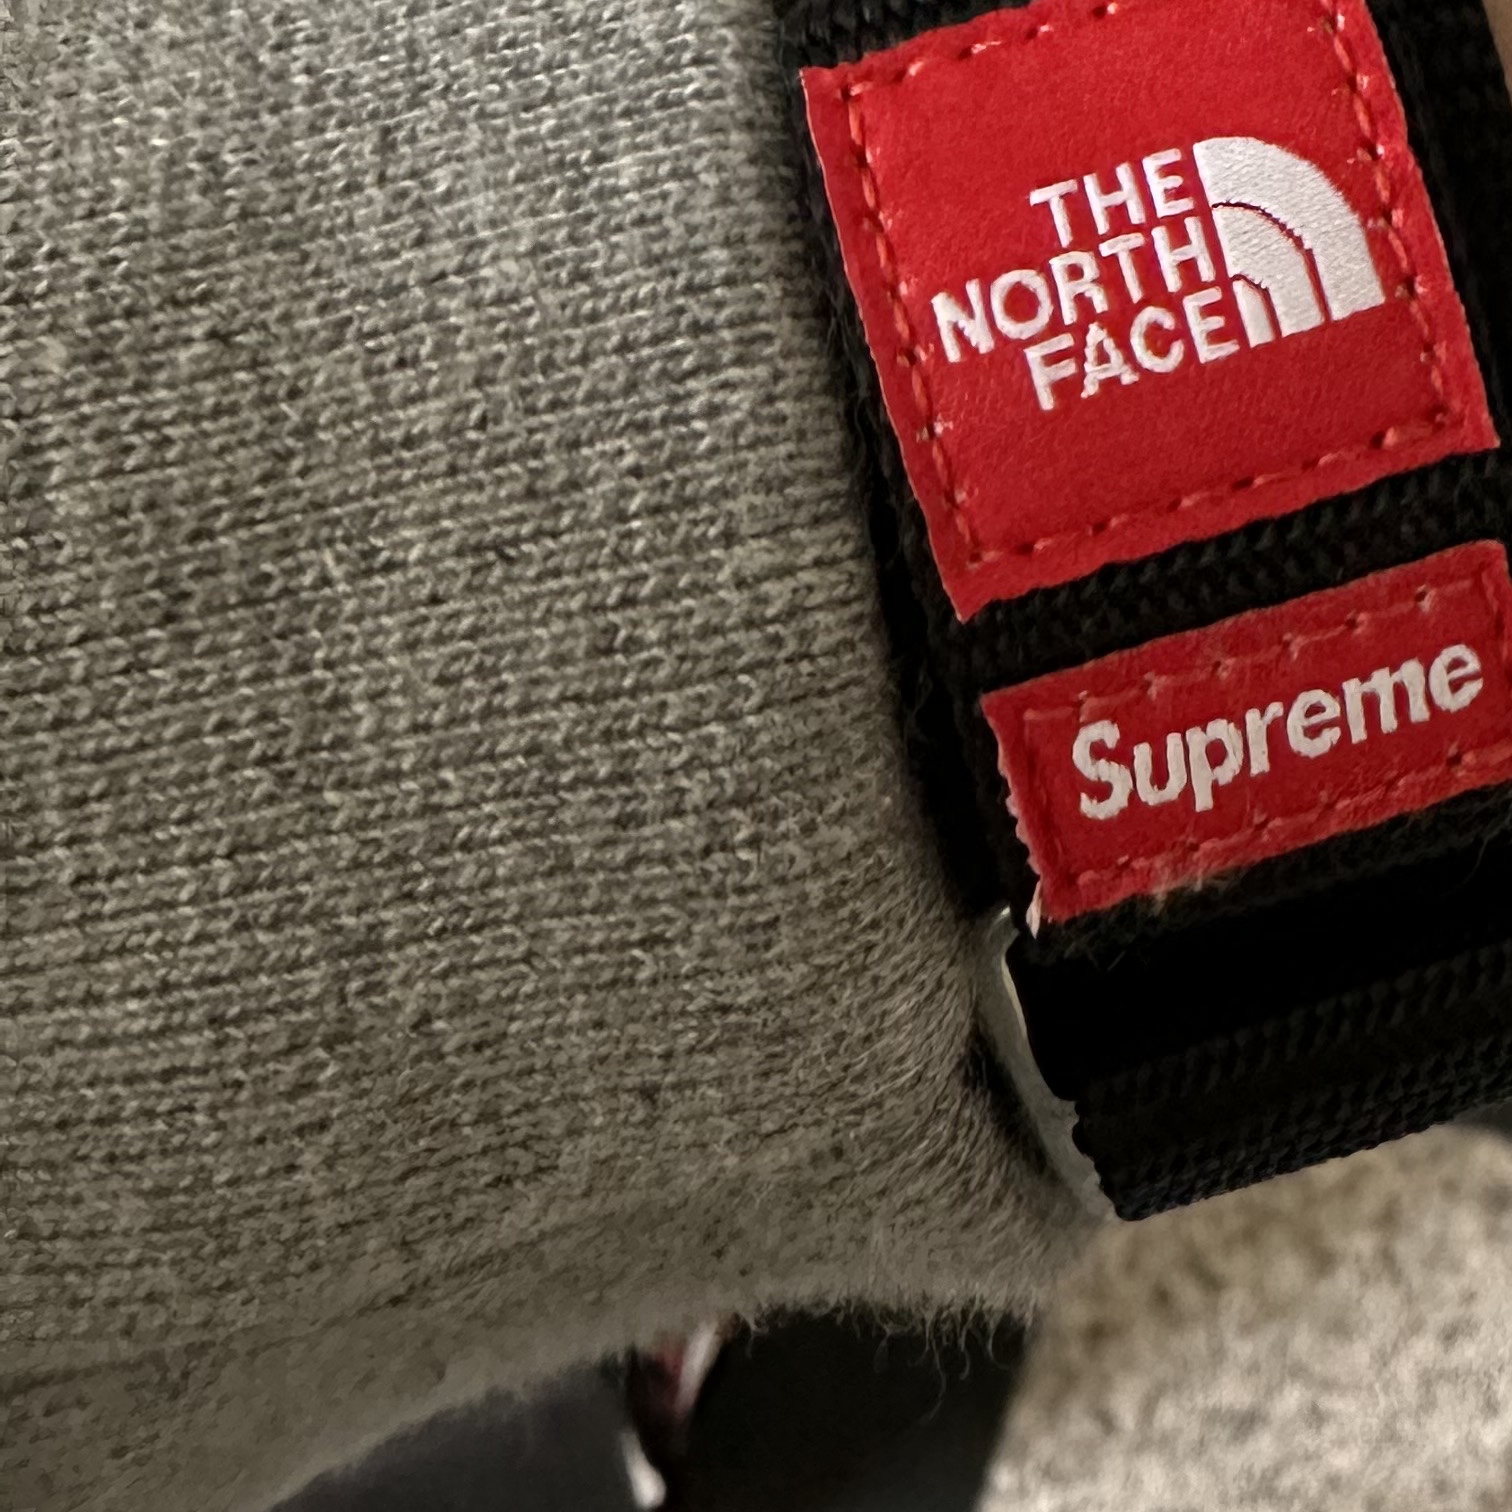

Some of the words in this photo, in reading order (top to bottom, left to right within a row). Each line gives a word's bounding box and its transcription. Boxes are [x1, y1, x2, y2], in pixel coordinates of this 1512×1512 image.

[1029, 147, 1195, 248] THE
[931, 217, 1215, 363] NORTH
[1025, 286, 1242, 411] FACE
[1071, 642, 1484, 821] Supreme
